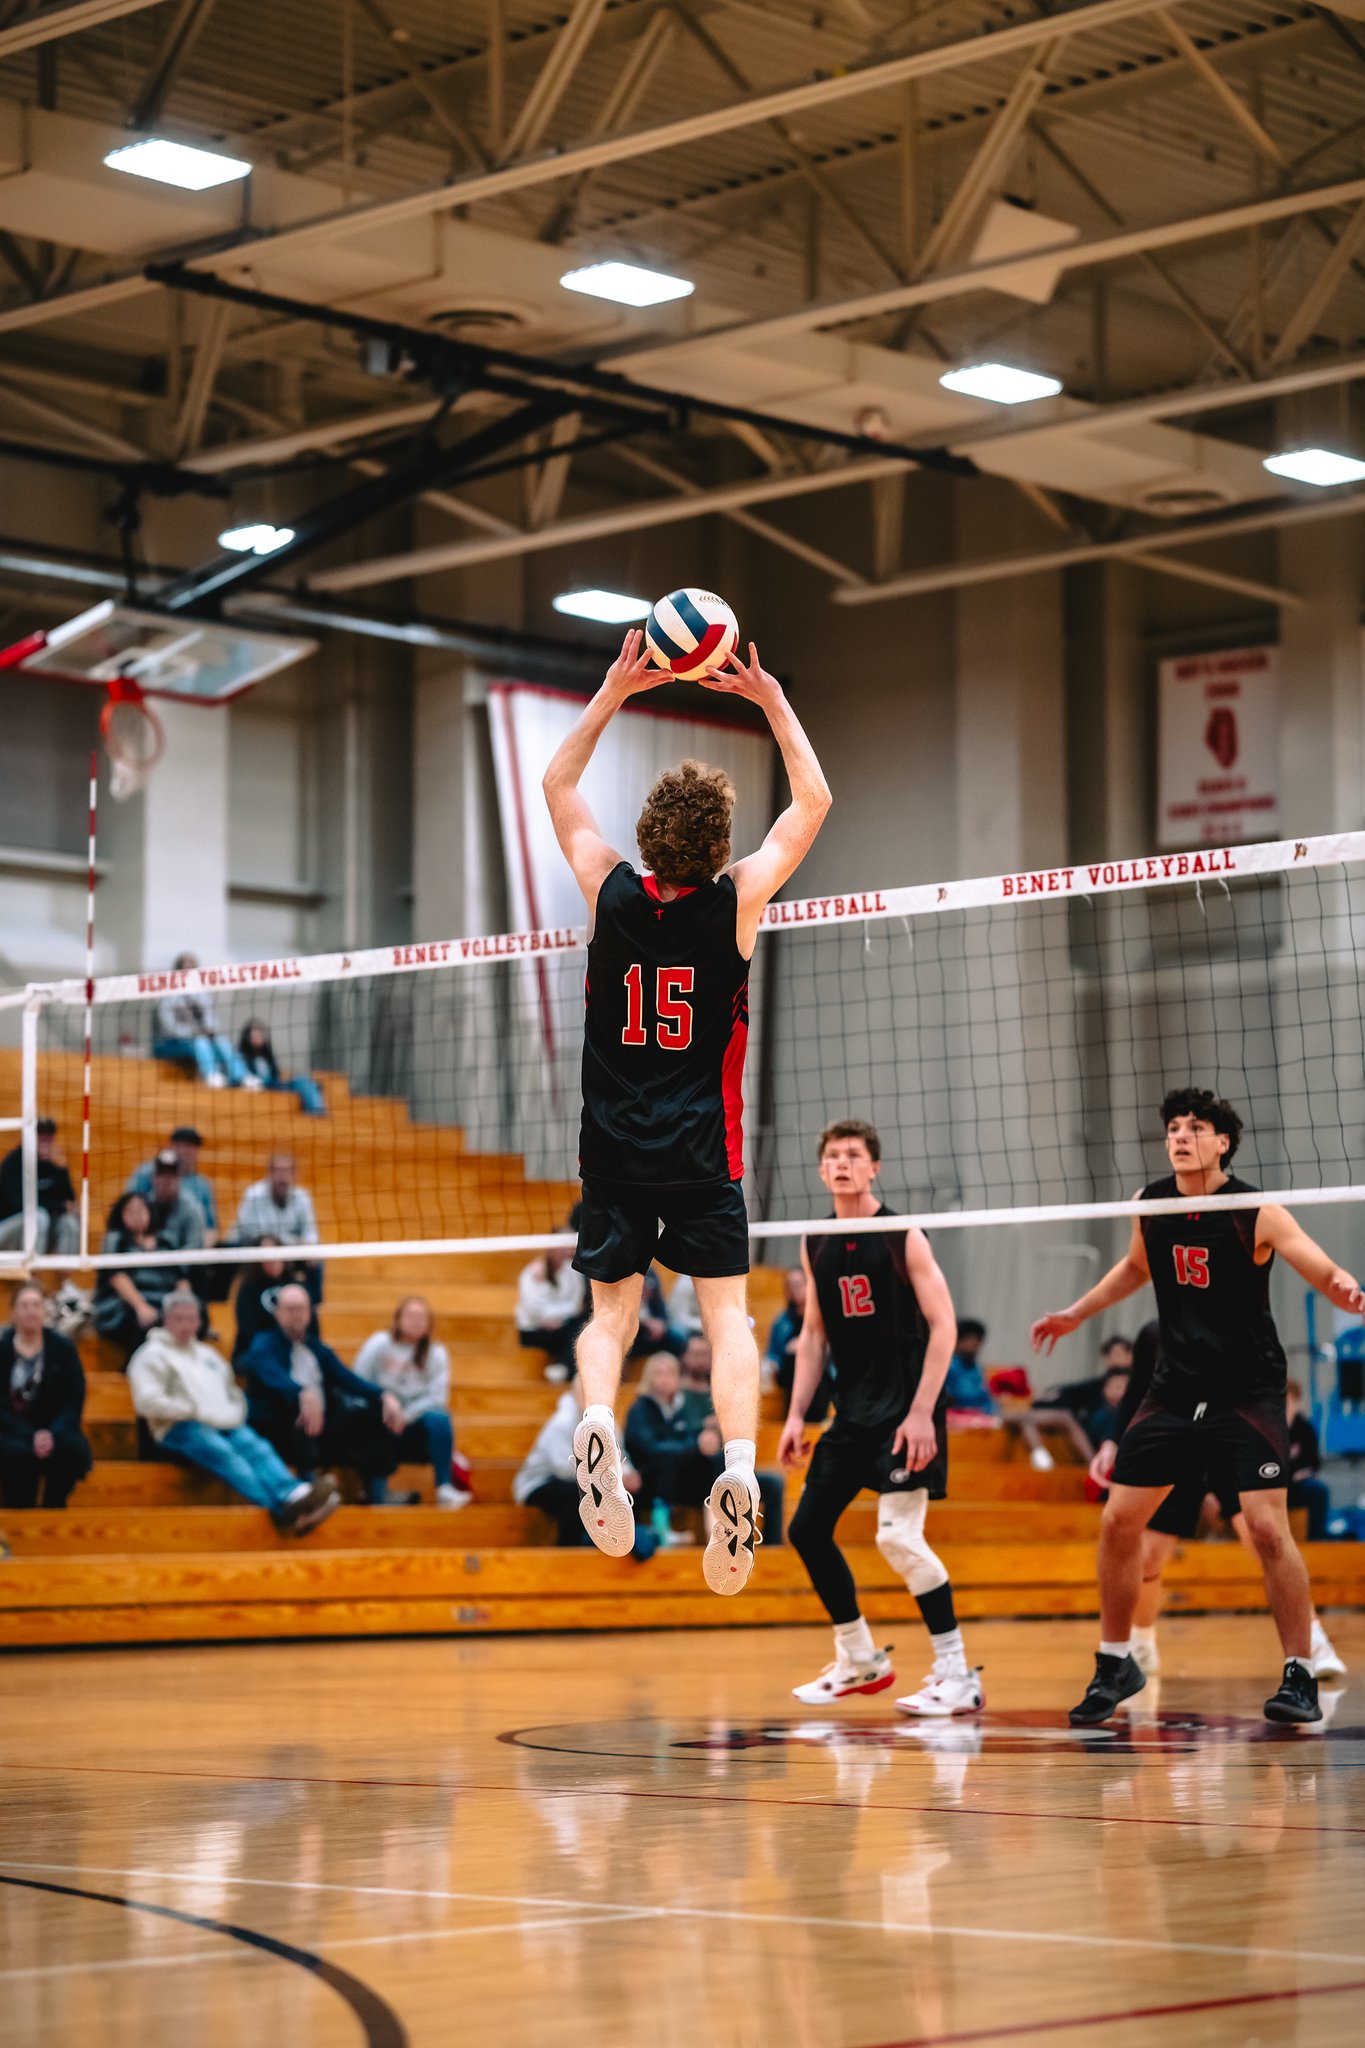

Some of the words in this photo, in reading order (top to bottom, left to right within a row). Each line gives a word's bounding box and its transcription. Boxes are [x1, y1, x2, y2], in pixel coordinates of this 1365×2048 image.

[1002, 870, 1075, 897] BENET
[1088, 849, 1237, 886] VOLLEYBALL
[393, 944, 452, 966] BENET
[461, 929, 577, 958] VOLLEYBALL
[138, 968, 189, 993] BENET
[199, 959, 302, 986] VOLLEYBALL
[622, 964, 695, 1051] 15
[1172, 1244, 1210, 1289] 15
[838, 1274, 875, 1318] 12
